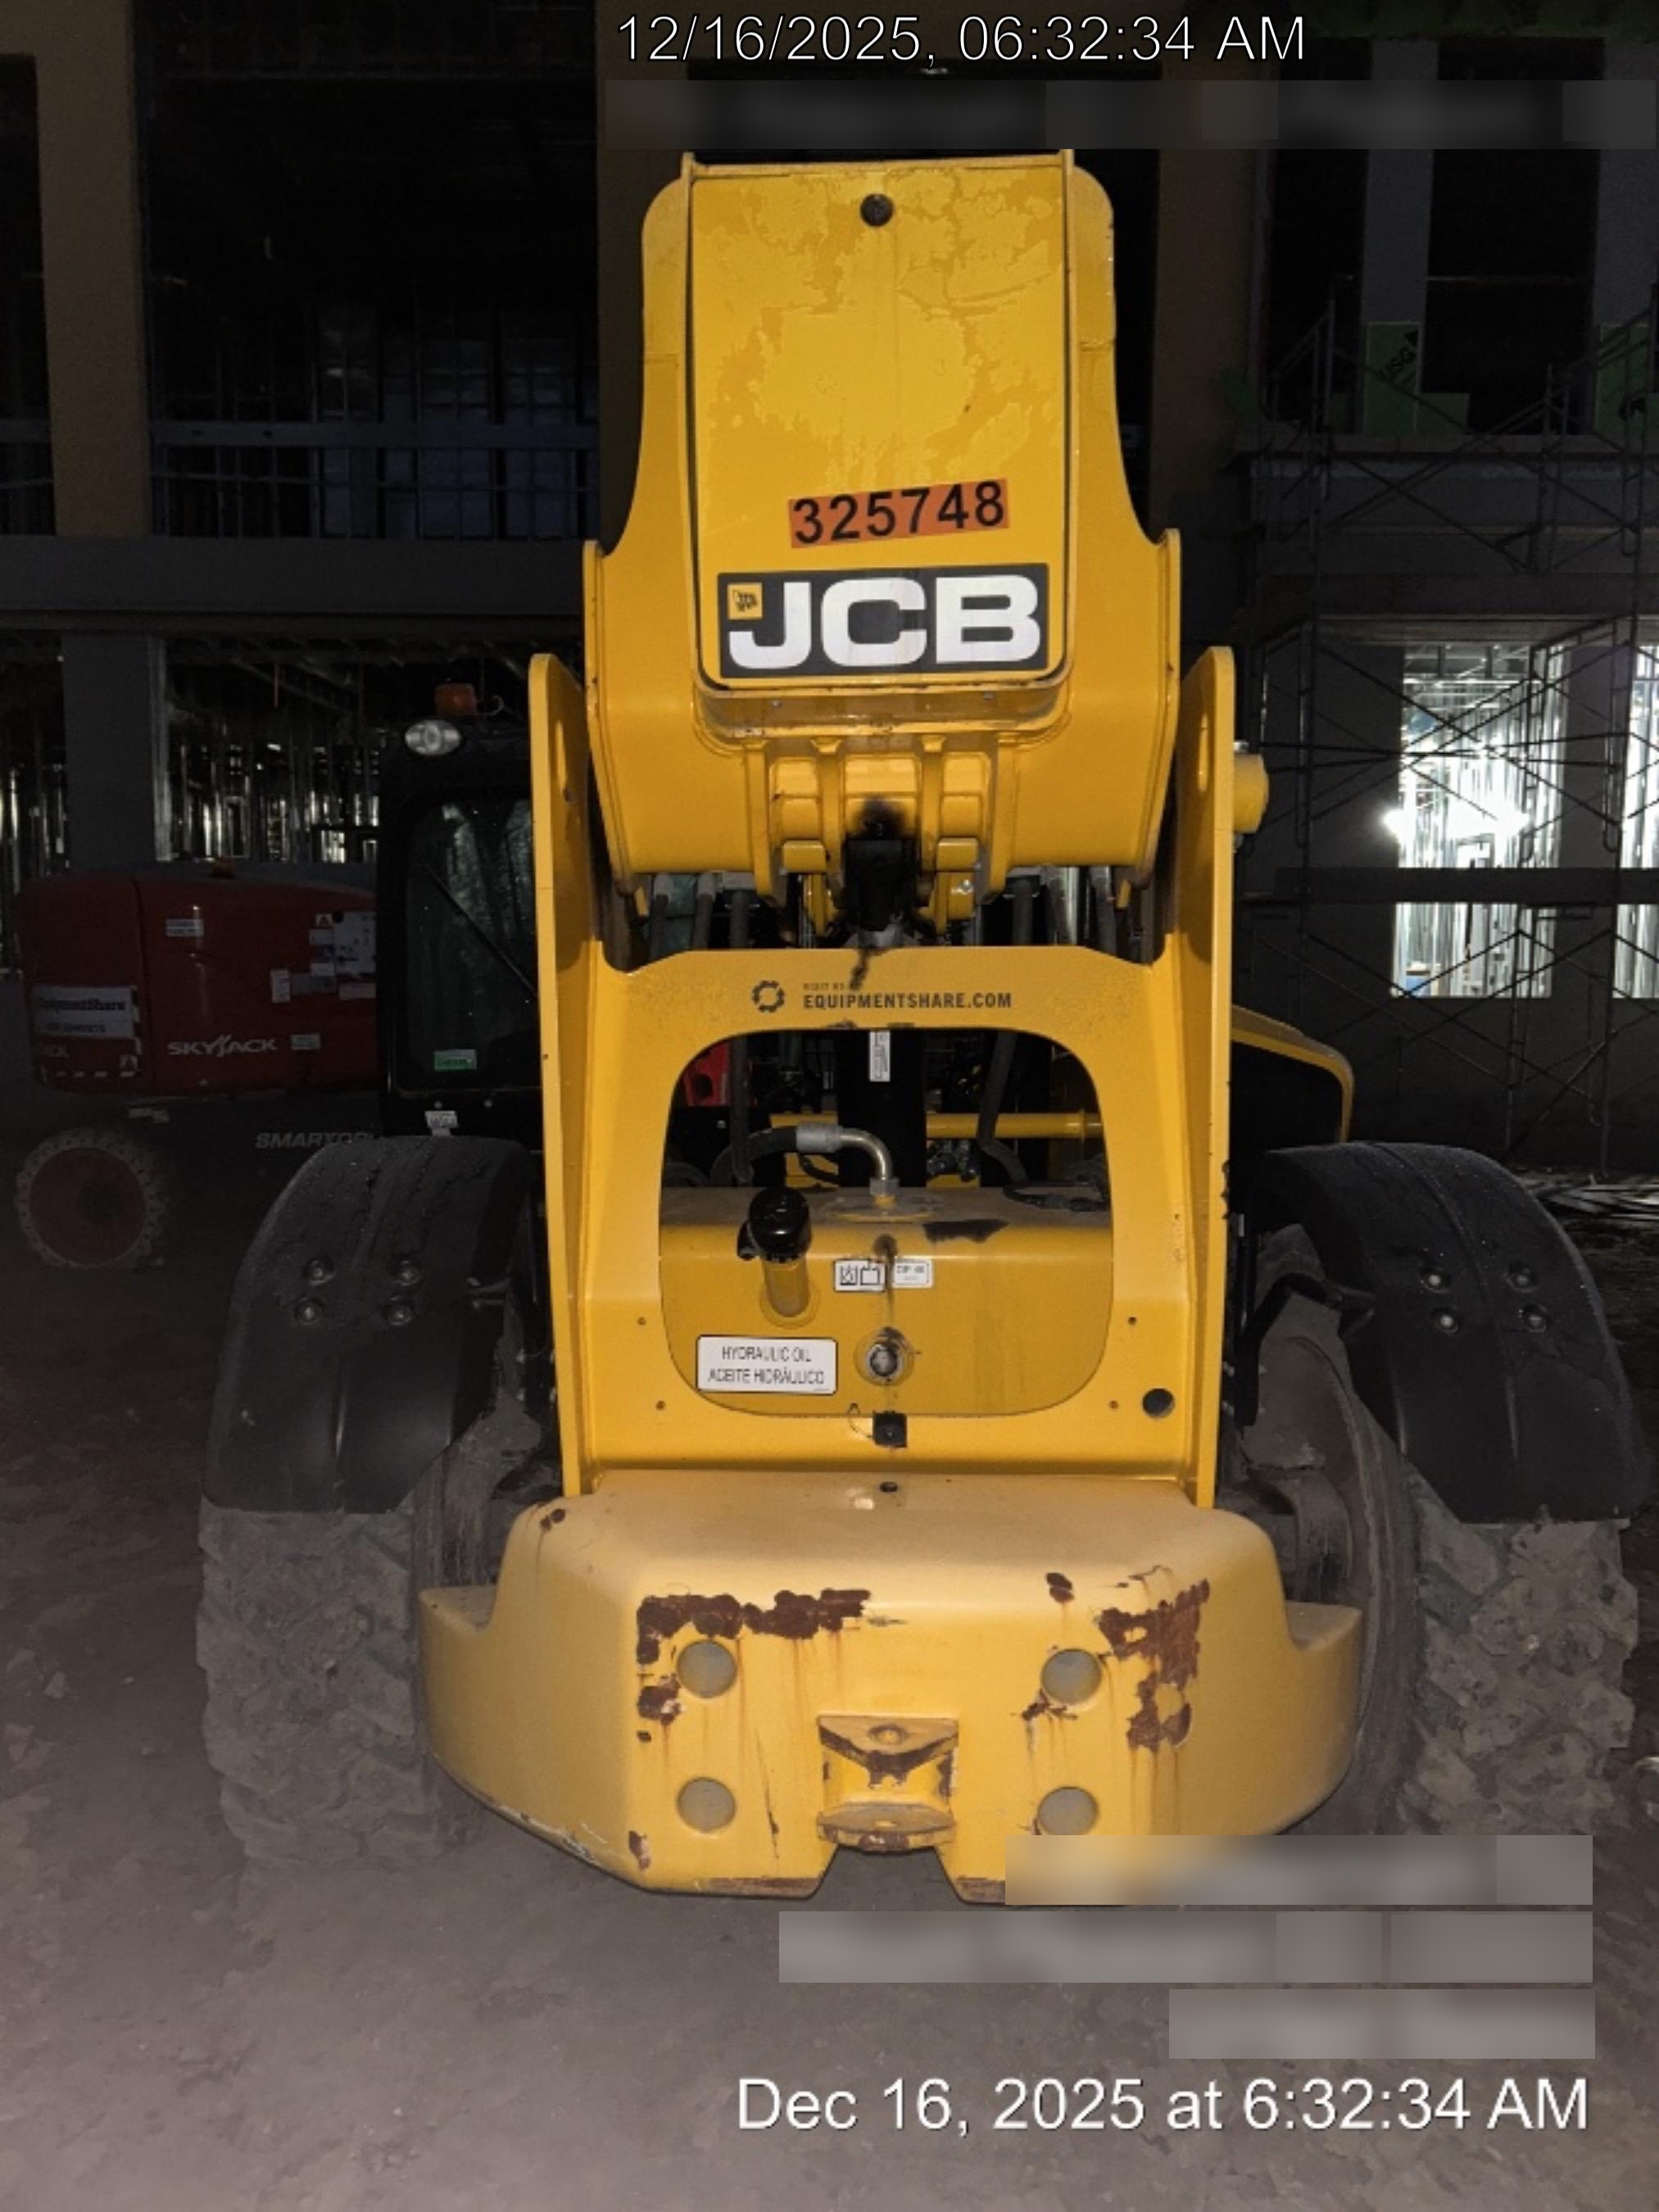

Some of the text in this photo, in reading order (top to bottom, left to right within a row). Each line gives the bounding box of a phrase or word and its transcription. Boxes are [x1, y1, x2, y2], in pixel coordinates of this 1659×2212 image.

[792, 480, 1004, 545] 325748
[728, 574, 1041, 669] JCB
[803, 992, 1012, 1010] EQUIPMENTSHARE.COM
[166, 1033, 278, 1058] SKYJACK
[721, 1346, 812, 1362] HYDRAULIC OIL
[708, 1367, 751, 1384] ACEITE
